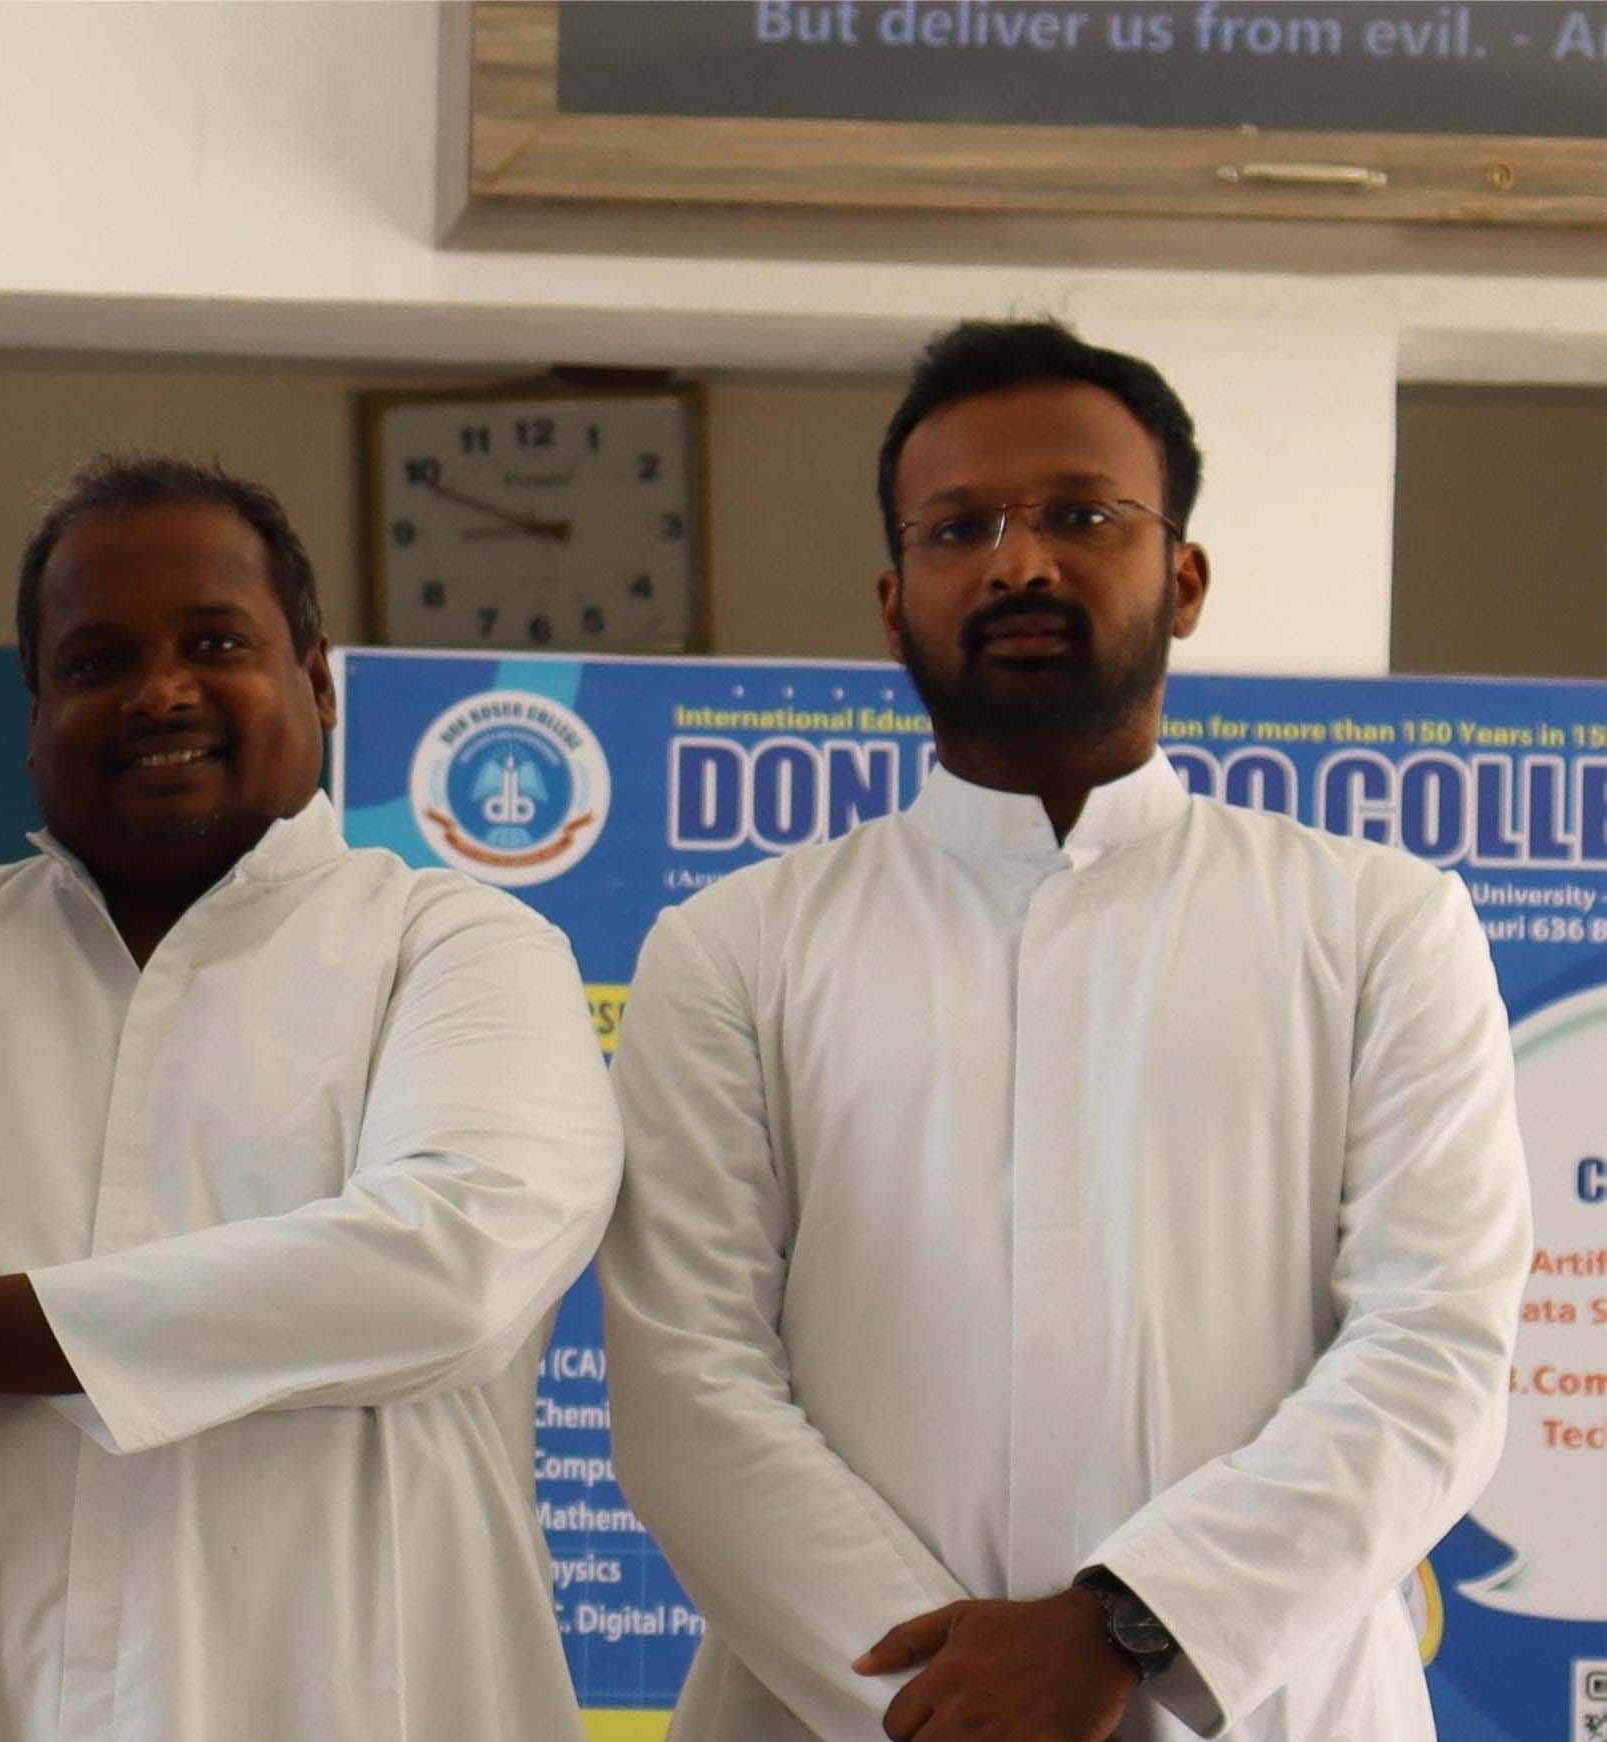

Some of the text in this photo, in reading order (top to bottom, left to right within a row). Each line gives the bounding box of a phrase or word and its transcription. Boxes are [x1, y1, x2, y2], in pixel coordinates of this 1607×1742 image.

[754, 0, 859, 44] But
[880, 0, 1088, 49] deliver
[1108, 11, 1175, 51] us
[1194, 0, 1344, 55] from
[1363, 6, 1486, 58] evil.
[1553, 10, 1607, 60] A
[459, 425, 491, 454] 11
[513, 418, 557, 448] 12
[404, 457, 442, 487] 10
[637, 452, 662, 482] 2
[629, 573, 655, 600] 4
[478, 606, 500, 638] 7
[675, 704, 853, 731] International
[1208, 714, 1251, 739] for
[1256, 719, 1327, 741] more
[1332, 716, 1395, 743] than
[1402, 720, 1451, 744] 150
[1458, 720, 1533, 746] Years
[1539, 722, 1566, 747] in
[668, 735, 901, 853] DON
[1471, 882, 1597, 913] University
[1483, 914, 1527, 942] uri
[1532, 917, 1585, 943] 636
[553, 1347, 607, 1382] (CA)
[577, 1602, 666, 1642] Digital
